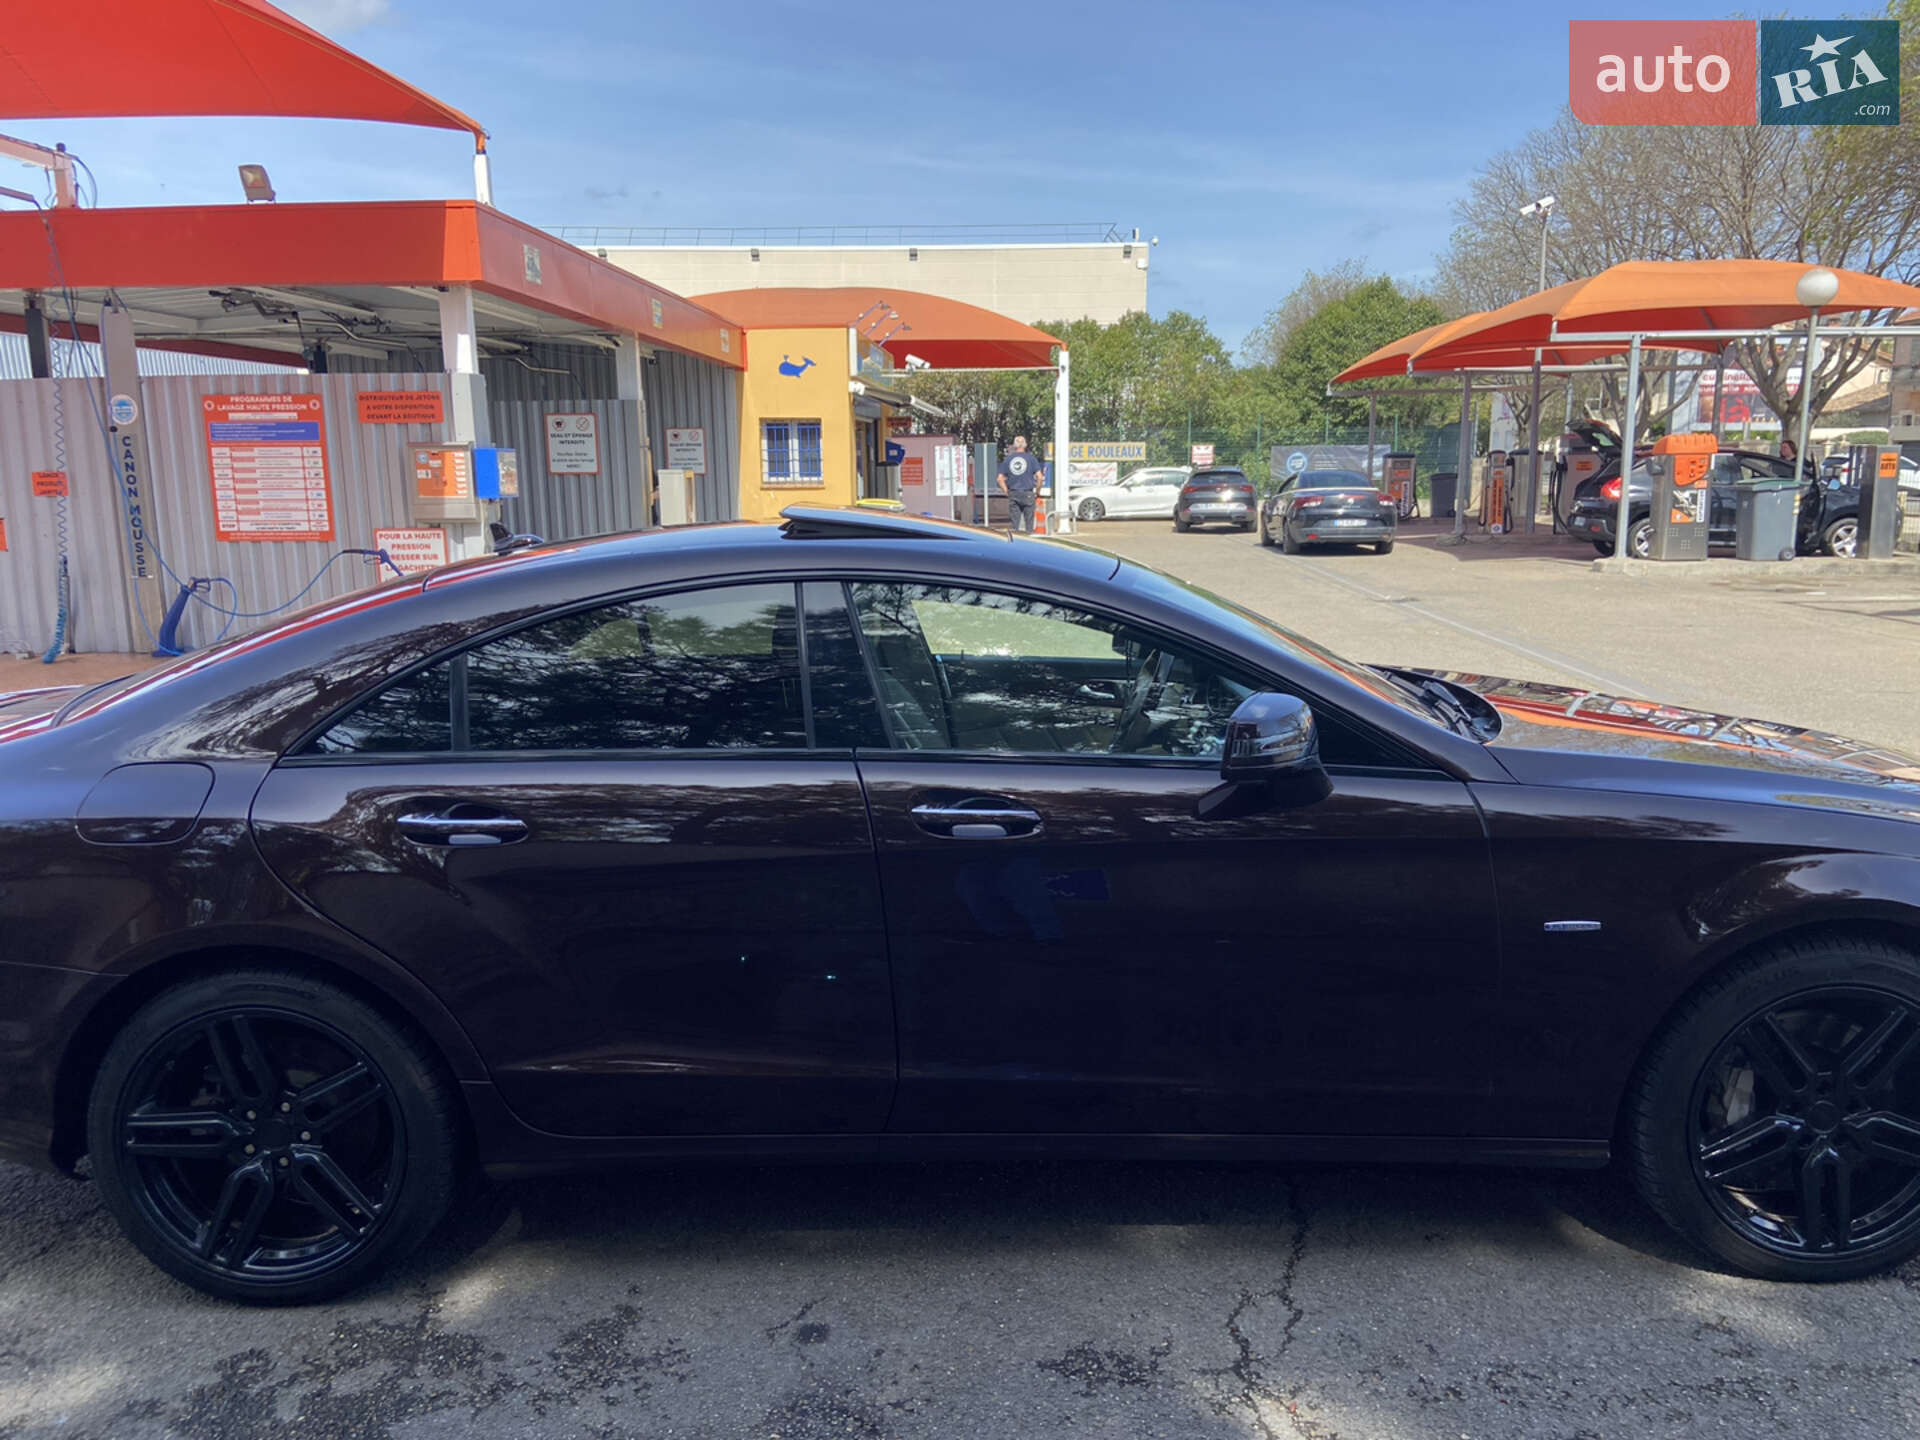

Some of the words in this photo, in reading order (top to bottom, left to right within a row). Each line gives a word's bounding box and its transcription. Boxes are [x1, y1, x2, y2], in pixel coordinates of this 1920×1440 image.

[1088, 445, 1142, 458] ROULEAUX
[122, 436, 138, 498] CANON
[130, 505, 147, 578] MOUSSE
